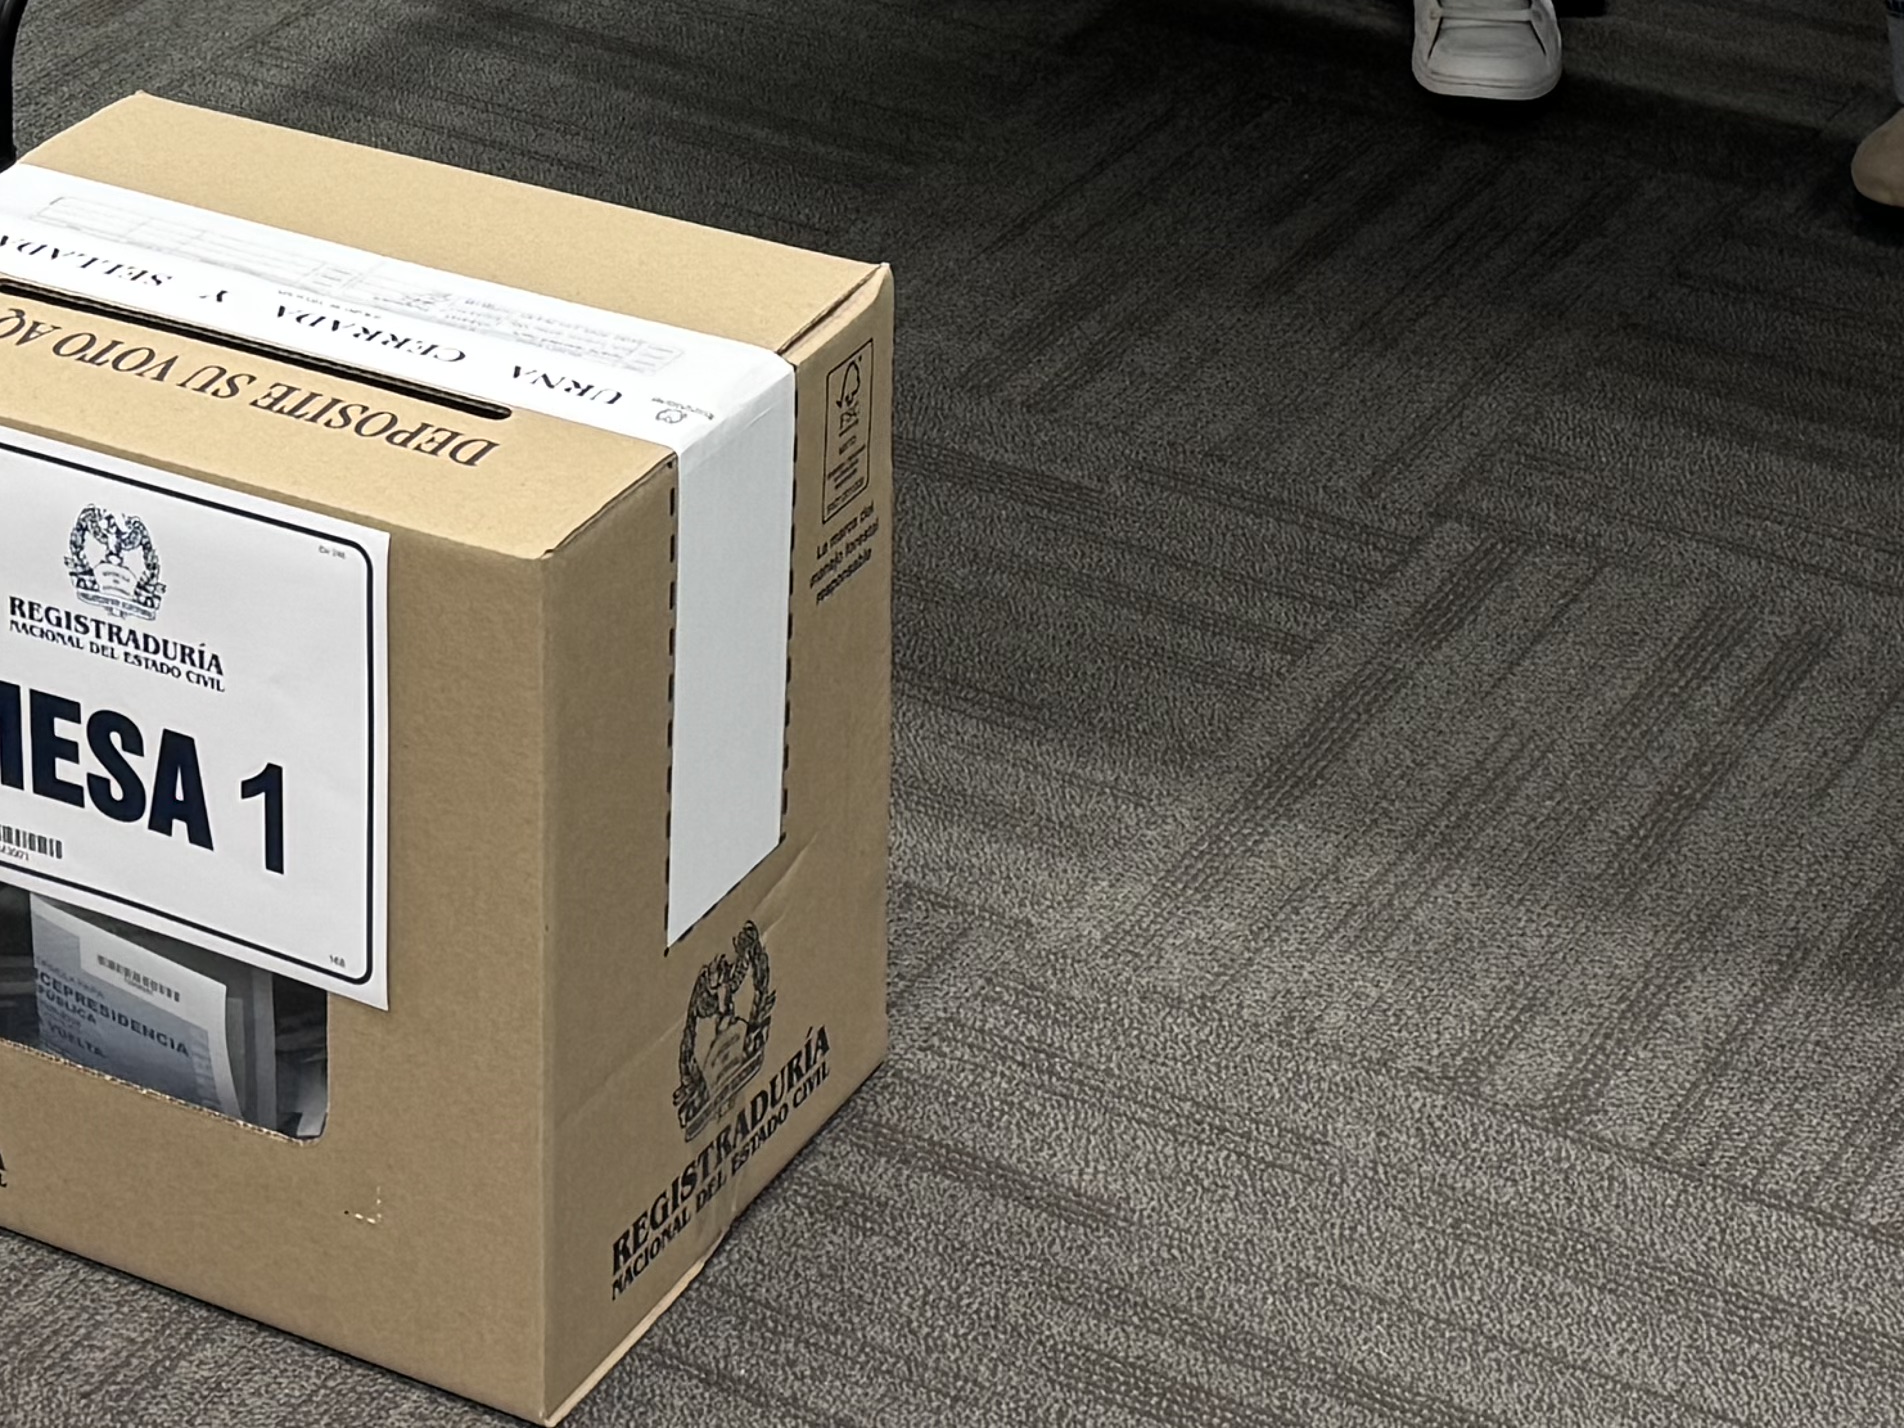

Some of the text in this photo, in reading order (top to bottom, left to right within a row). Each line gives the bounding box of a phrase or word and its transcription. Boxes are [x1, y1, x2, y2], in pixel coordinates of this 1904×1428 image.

[0, 235, 174, 286] SELLADA
[52, 332, 179, 382] VOTO
[276, 304, 466, 364] CERRADA
[178, 365, 256, 399] SU
[511, 365, 623, 406] URNA
[249, 382, 500, 467] DEPOSITE
[9, 596, 224, 676] REGISTRADURÍA
[10, 620, 225, 692] NACIONAL DEL ESTADO CIVIL
[241, 762, 285, 875] 1
[612, 1209, 691, 1301] NACIONAL
[695, 1174, 726, 1215] DEL
[731, 1103, 788, 1176] ESTADO
[792, 1060, 830, 1108] CIVIL
[613, 1025, 830, 1276] REGISTRADURÍA
